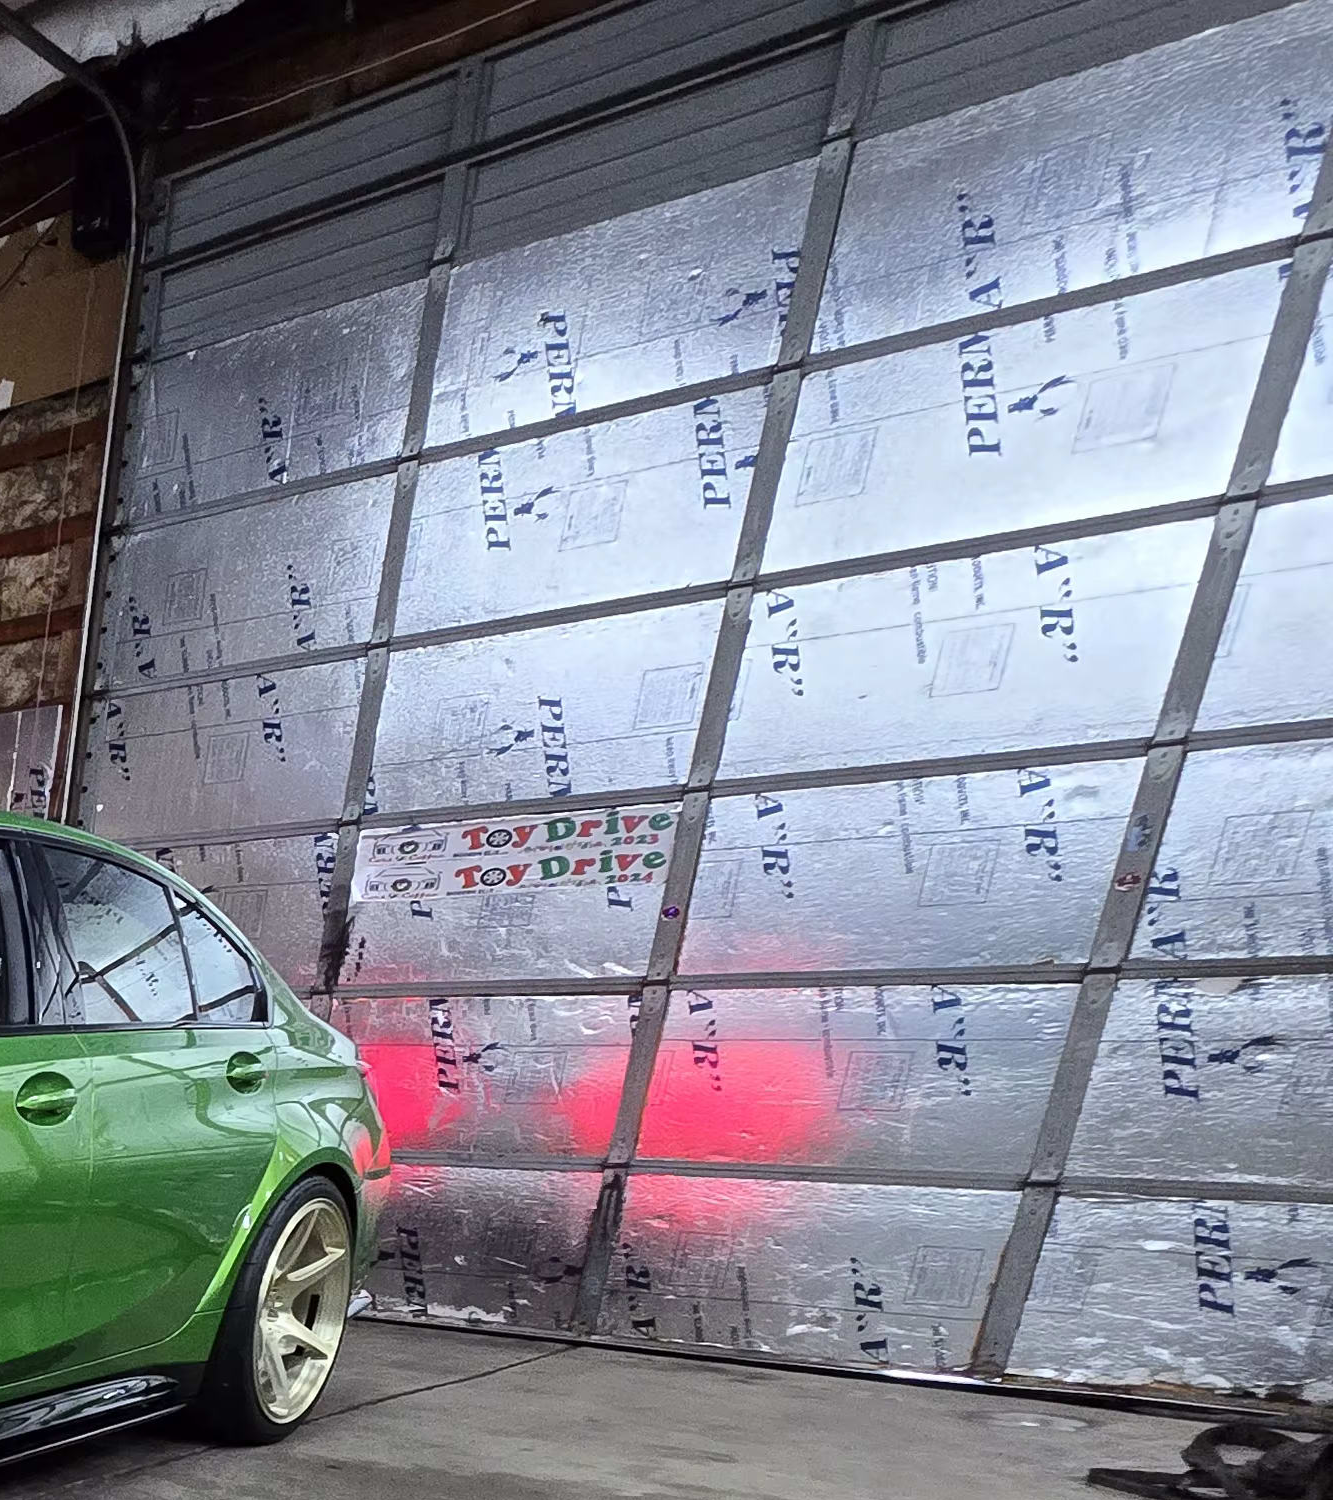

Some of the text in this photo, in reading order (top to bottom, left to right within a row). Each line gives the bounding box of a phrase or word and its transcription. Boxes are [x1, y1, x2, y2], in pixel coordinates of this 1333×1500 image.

[462, 823, 539, 851] Toy
[545, 807, 676, 843] Drive
[609, 833, 661, 847] 2023
[454, 849, 668, 890] Toy Drive
[604, 870, 654, 884] 2024
